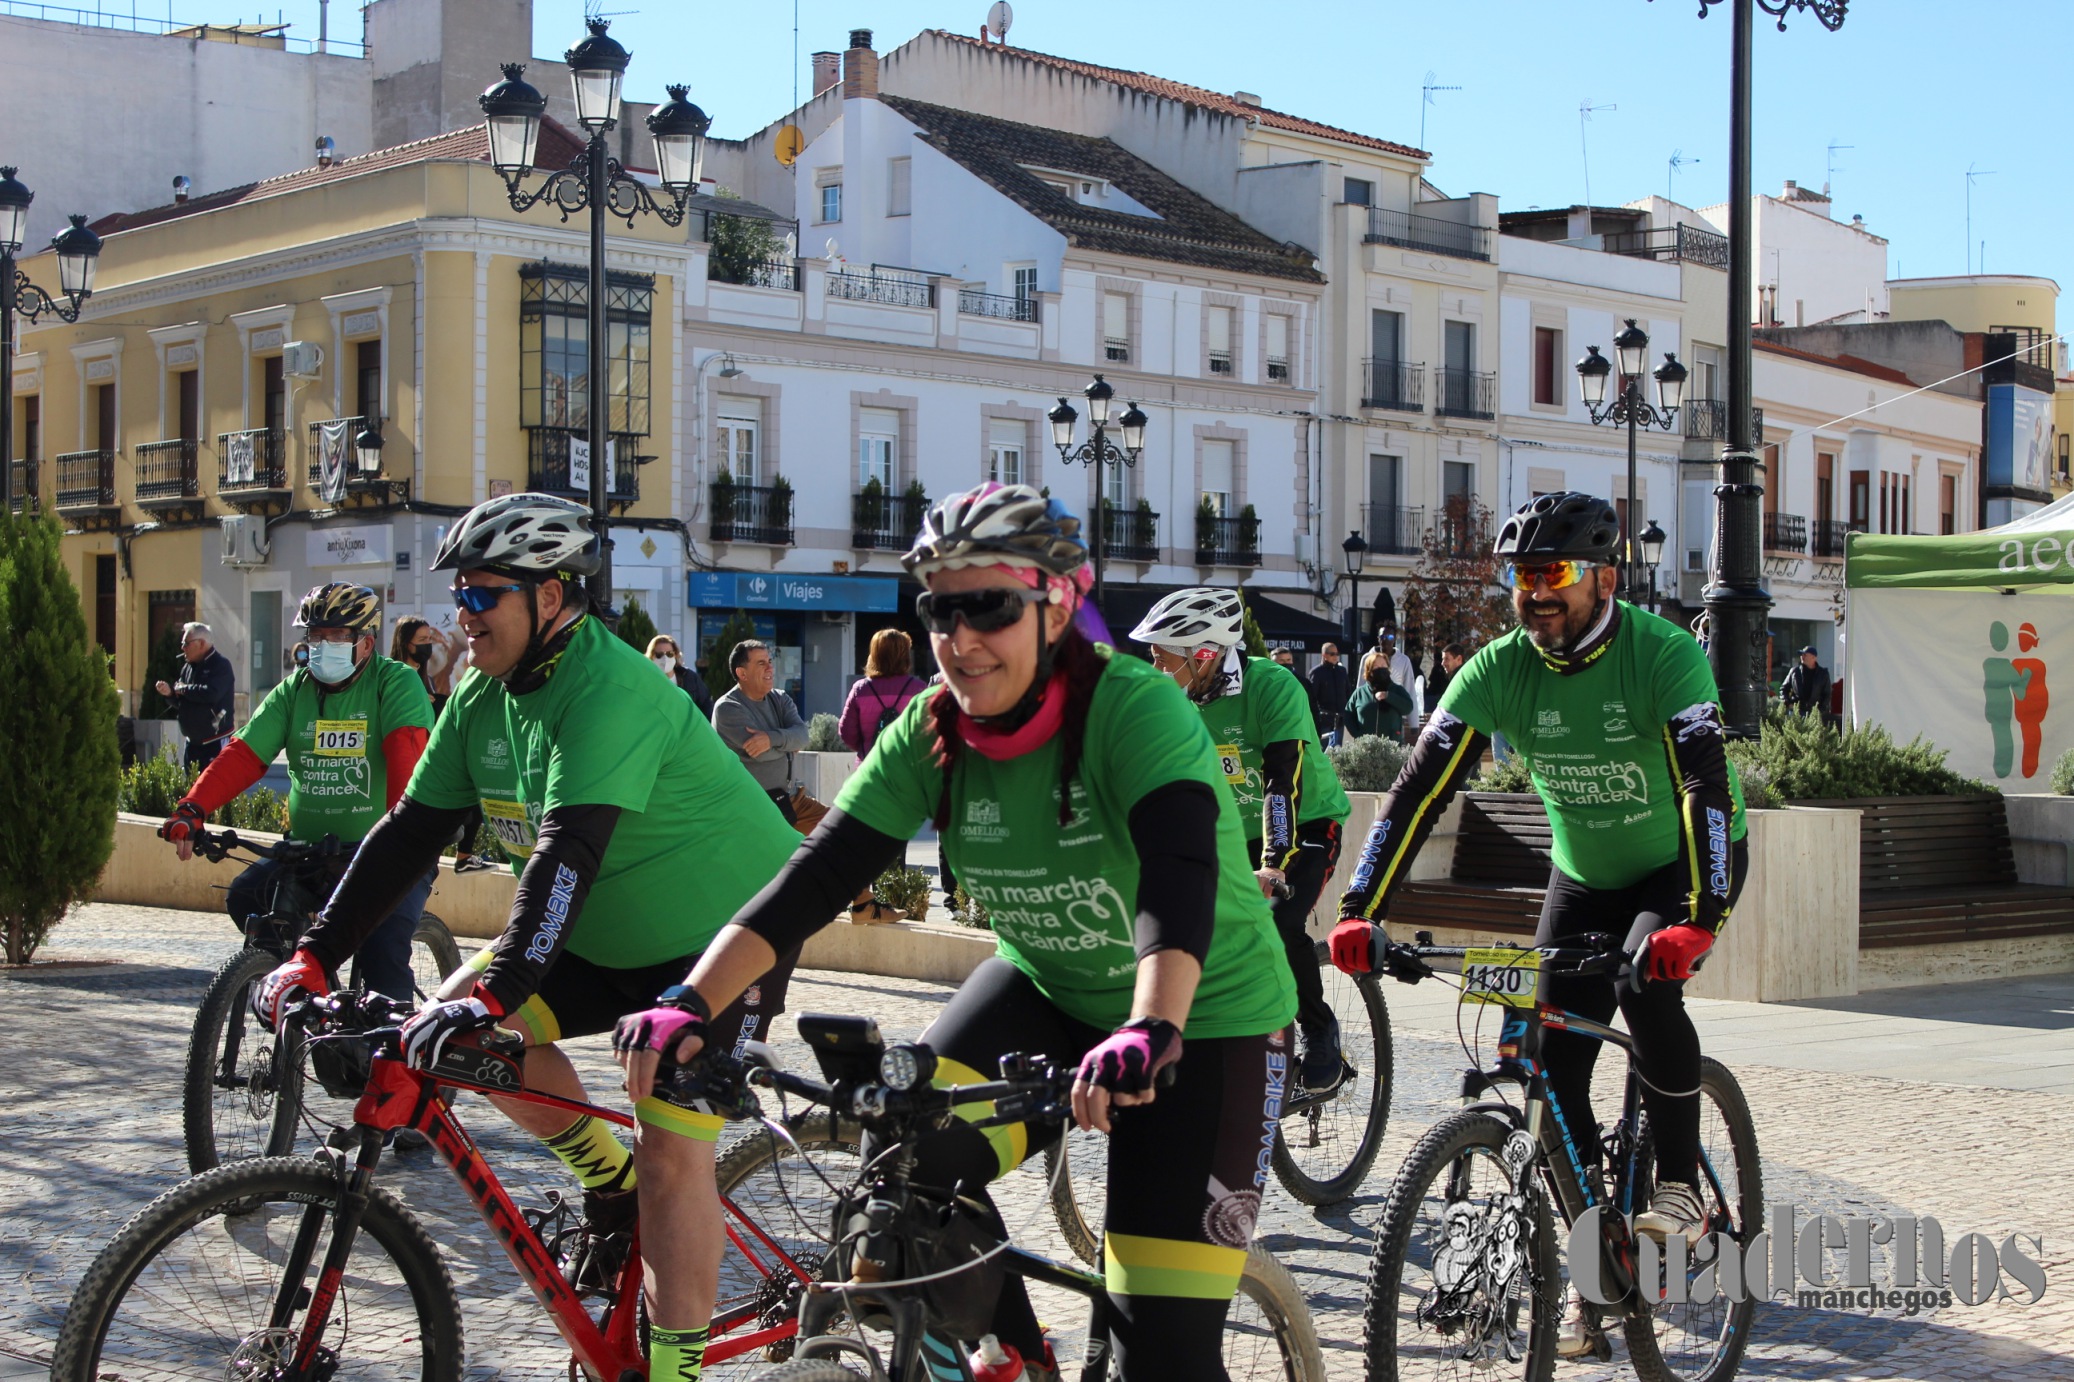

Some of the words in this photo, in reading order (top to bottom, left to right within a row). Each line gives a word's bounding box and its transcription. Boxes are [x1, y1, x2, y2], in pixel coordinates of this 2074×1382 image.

[783, 582, 823, 602] Viajes
[1200, 602, 1221, 615] SCOTT
[317, 731, 358, 748] 1015
[300, 755, 314, 768] En
[1533, 759, 1556, 776] En
[1560, 760, 1637, 777] marcha
[303, 770, 339, 781] contra
[301, 782, 310, 793] el
[312, 783, 359, 796] cáncer
[1271, 794, 1289, 847] OMBIKE
[1349, 818, 1392, 894] TOMBIK
[1003, 866, 1048, 878] TOMELLOSO
[965, 876, 999, 903] En
[1001, 875, 1108, 905] marcha
[524, 861, 578, 964] TOMBIKE
[1021, 929, 1110, 952] cáncer
[1470, 950, 1500, 958] Tomelloso
[1253, 1050, 1287, 1188] TOMBIKE
[286, 1191, 319, 1203] SWISS
